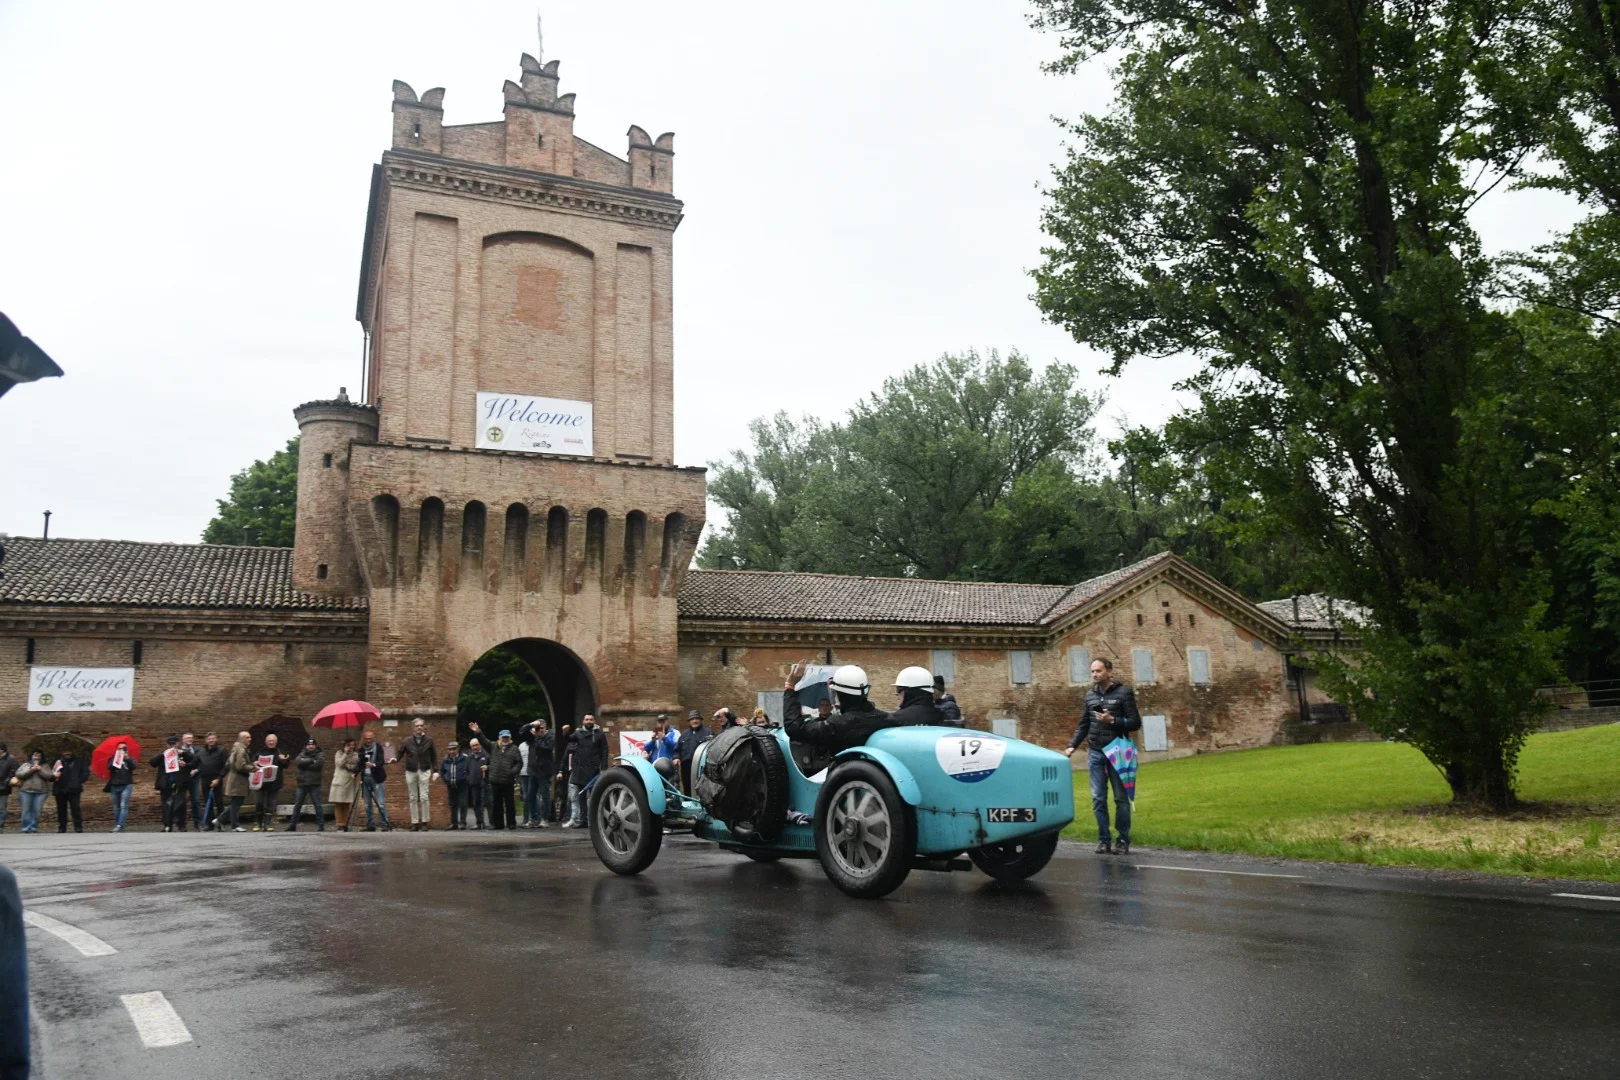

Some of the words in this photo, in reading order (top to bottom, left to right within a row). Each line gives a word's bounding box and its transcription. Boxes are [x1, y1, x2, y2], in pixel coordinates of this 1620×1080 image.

[484, 398, 585, 427] Welcome
[36, 670, 126, 690] Welcome
[958, 739, 982, 757] 19
[988, 808, 1018, 822] KPF
[1024, 808, 1035, 822] 3
